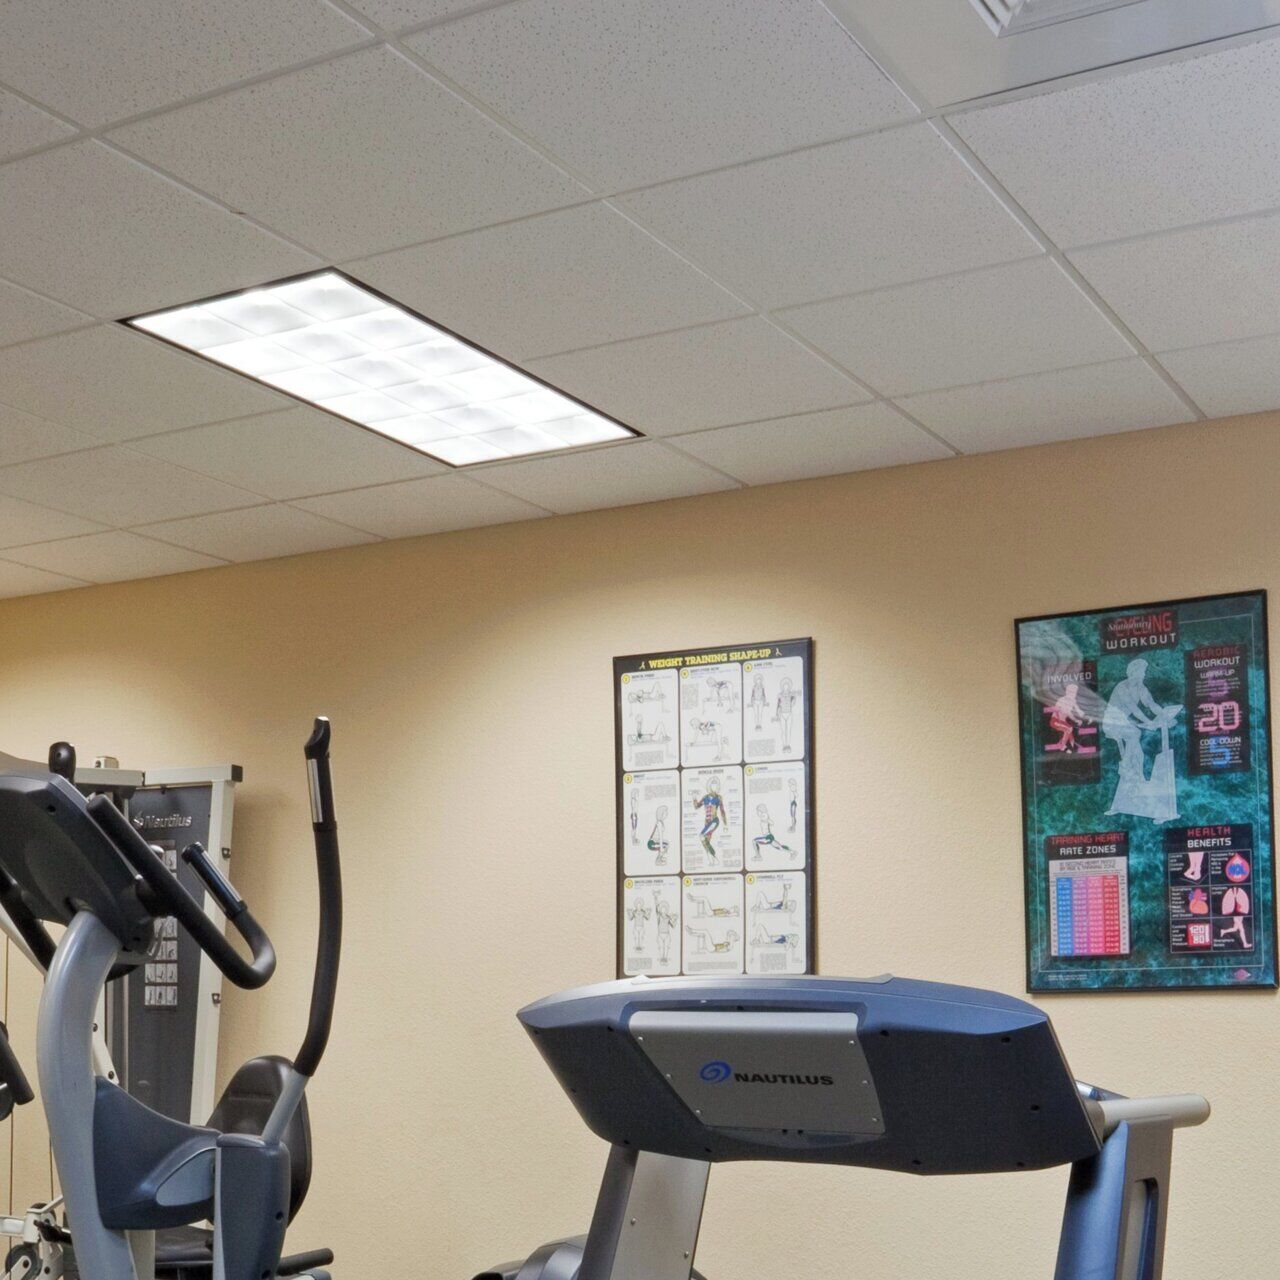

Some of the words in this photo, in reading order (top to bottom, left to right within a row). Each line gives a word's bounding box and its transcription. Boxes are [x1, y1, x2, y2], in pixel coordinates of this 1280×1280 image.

[1106, 632, 1176, 650] WORKOUT
[649, 657, 683, 669] WEIGHT
[685, 653, 728, 665] TRAINING
[729, 648, 771, 661] SHAPE-UP
[1194, 656, 1240, 668] WORKOUT
[1047, 671, 1092, 684] INVOLVED
[1198, 701, 1240, 733] 20
[144, 814, 192, 828] Nautilus
[1187, 826, 1231, 837] HEALTH
[1187, 837, 1232, 848] BENEFITS
[1060, 847, 1083, 856] RATE
[1086, 844, 1116, 854] ZONES
[734, 1073, 834, 1086] NAUTILUS
